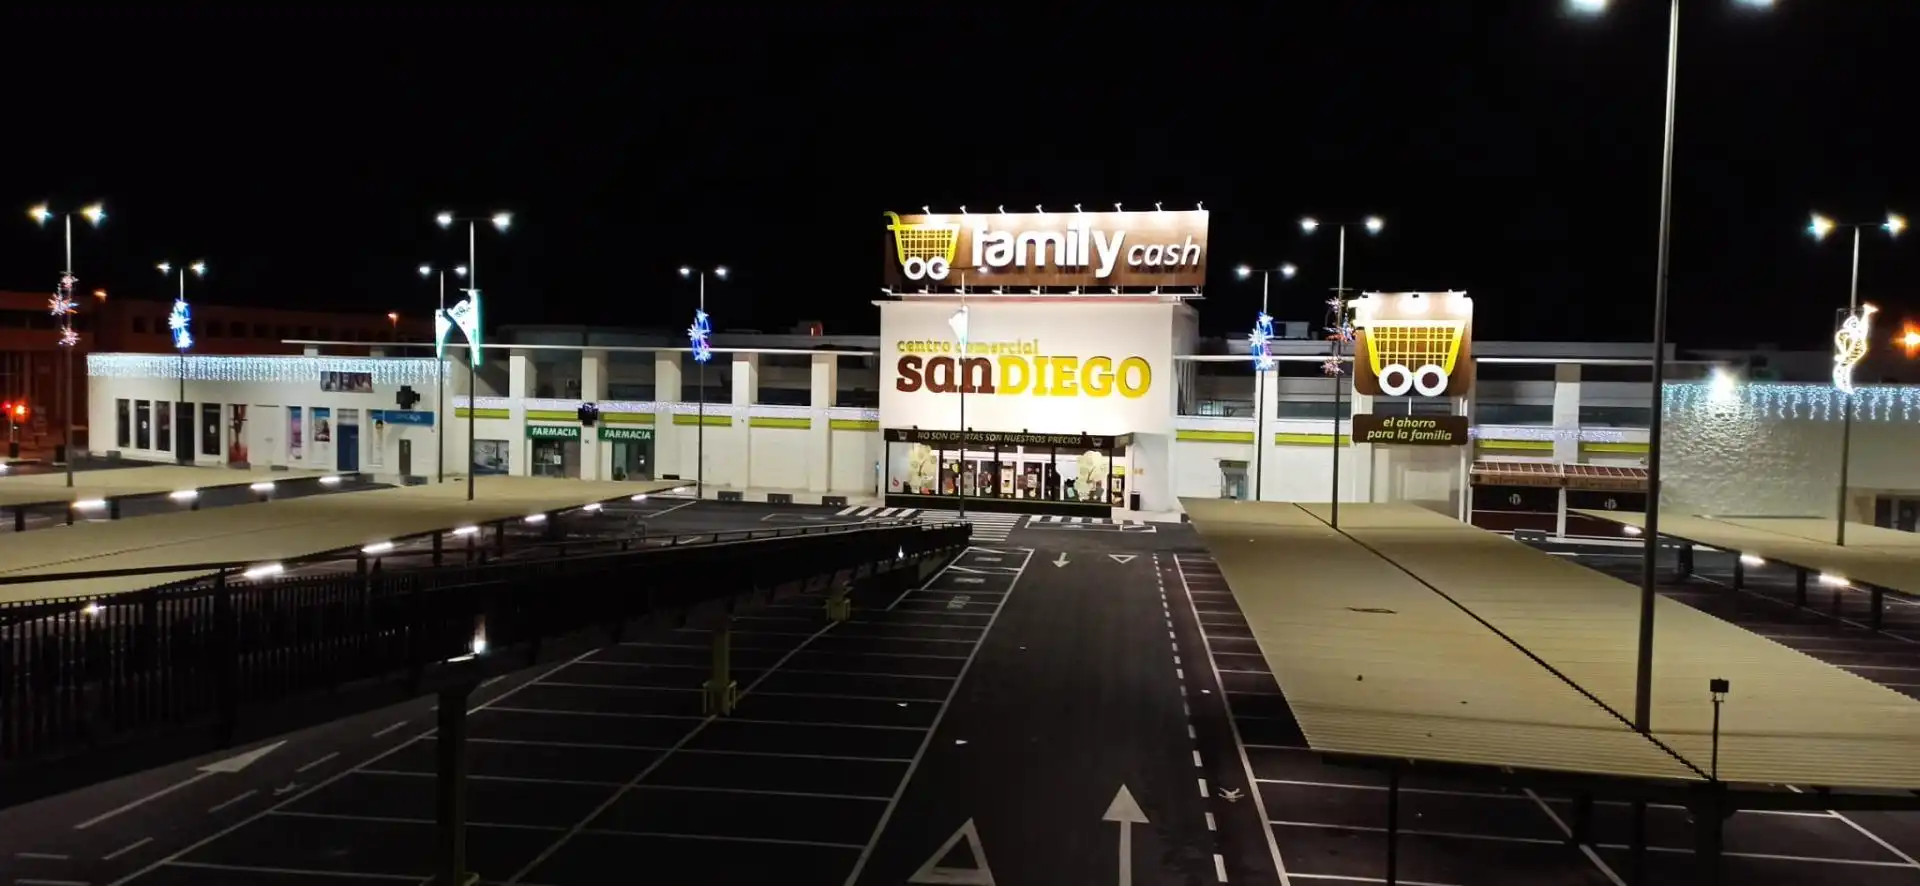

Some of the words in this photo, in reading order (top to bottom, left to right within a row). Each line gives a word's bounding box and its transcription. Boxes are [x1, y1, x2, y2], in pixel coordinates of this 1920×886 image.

[972, 216, 1126, 278] family
[1127, 235, 1201, 266] cash
[896, 340, 951, 353] centro
[1383, 417, 1394, 428] el
[1396, 417, 1436, 428] ahorro
[532, 427, 578, 437] FARMACIA
[605, 429, 651, 440] FARMACIA
[917, 431, 930, 440] NO
[931, 432, 948, 441] SON
[950, 432, 983, 442] OFRTAS
[985, 433, 1002, 442] SON
[1004, 434, 1046, 443] NUESTROS
[1048, 436, 1081, 445] PRECIOS
[1367, 429, 1394, 441] para
[1397, 429, 1408, 440] la
[1410, 430, 1453, 442] familia
